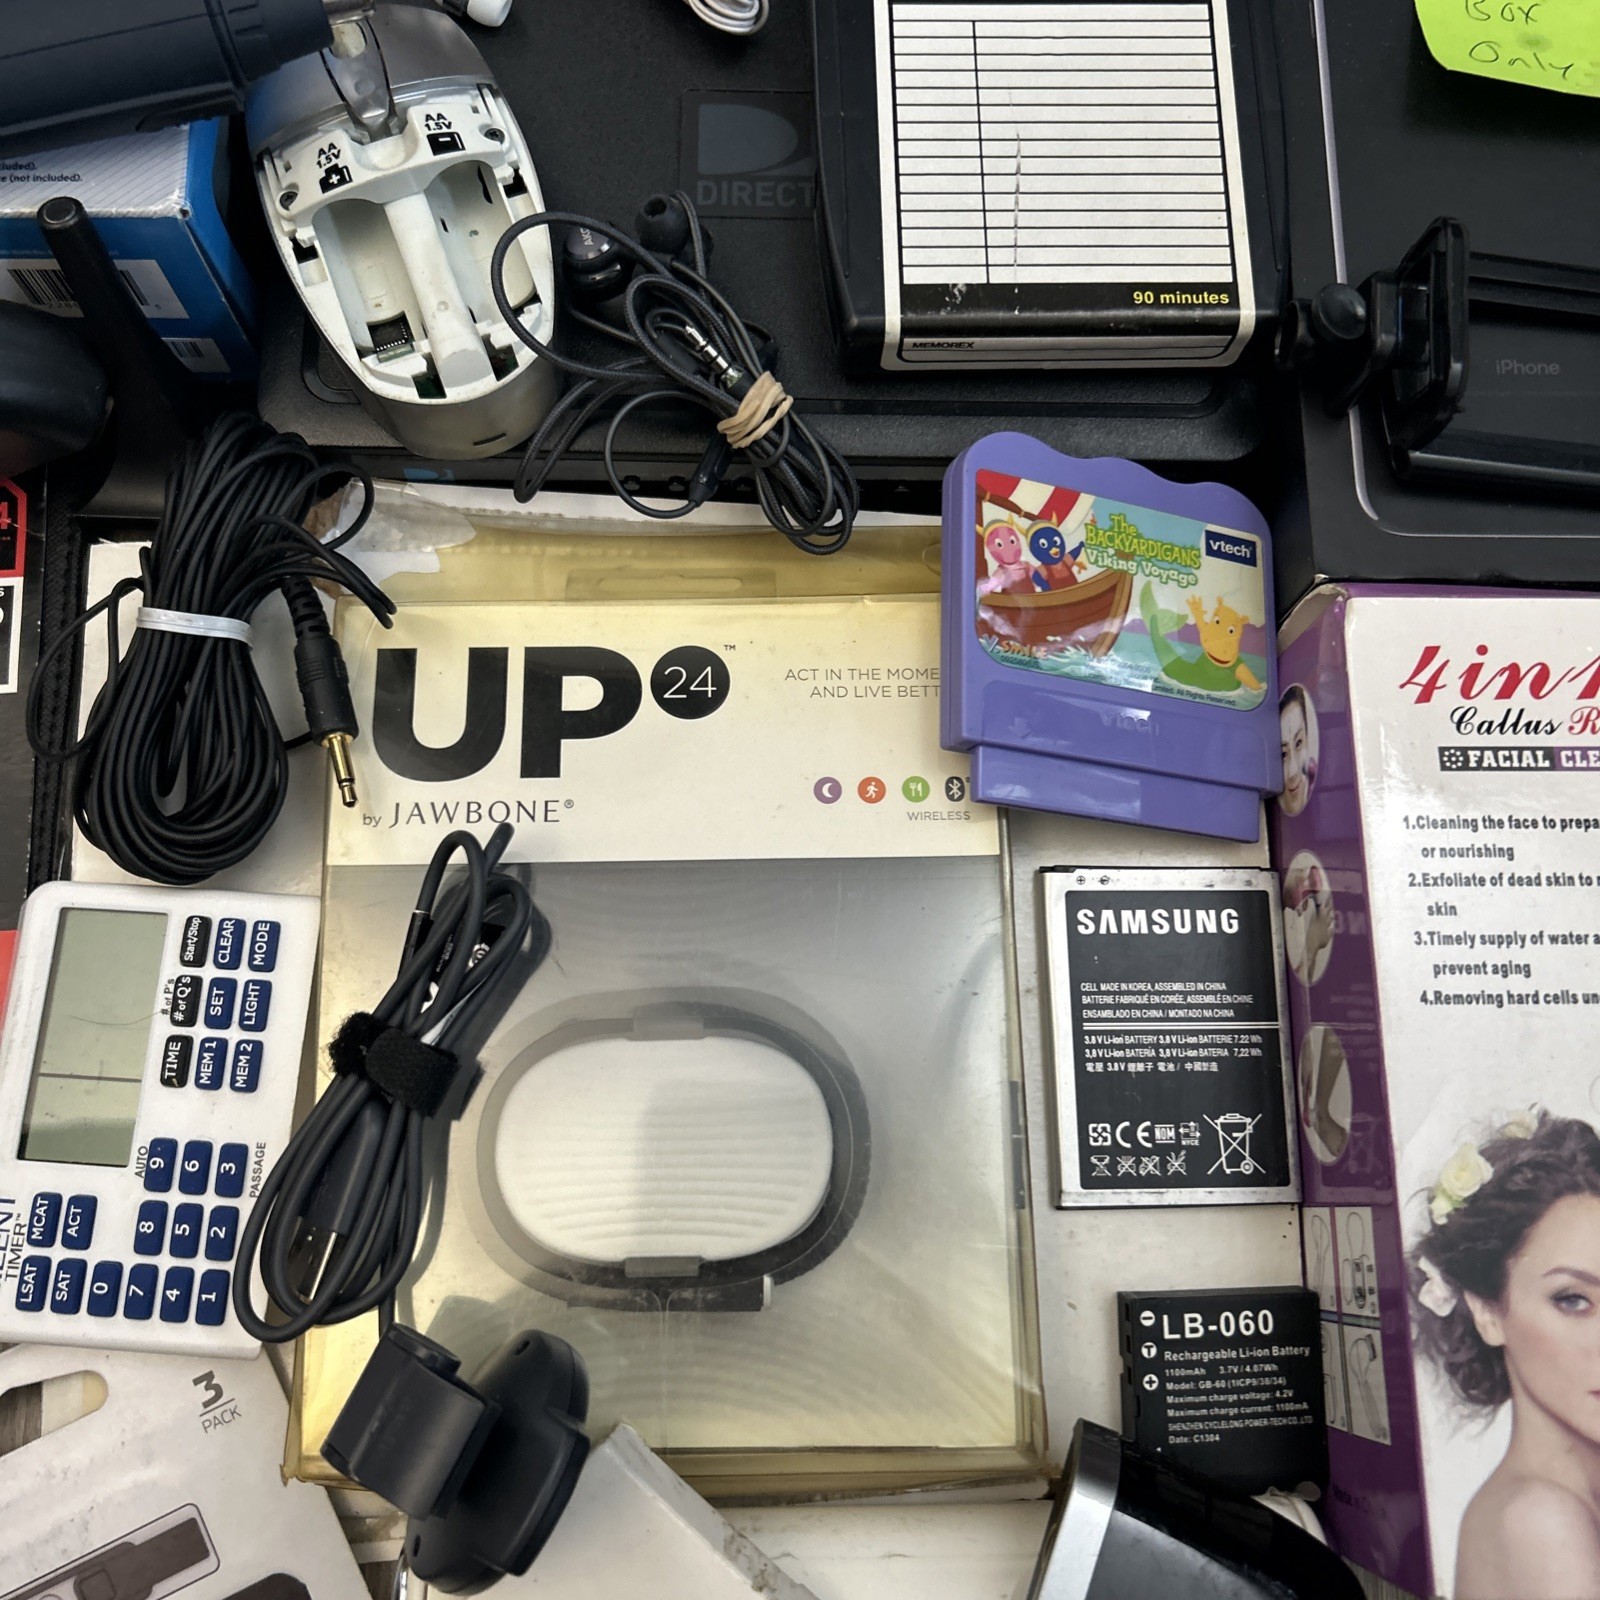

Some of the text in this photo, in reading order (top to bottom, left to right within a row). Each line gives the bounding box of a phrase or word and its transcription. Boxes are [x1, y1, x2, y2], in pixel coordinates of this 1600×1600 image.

[1468, 40, 1574, 80] Only
[424, 113, 448, 122] AA
[425, 121, 452, 132] 1.5V
[317, 142, 338, 159] AA
[316, 149, 341, 169] 1.5V
[1133, 291, 1229, 304] 90 minutes
[912, 341, 975, 349] MEMOREX
[1495, 359, 1560, 376] iPhone
[1109, 513, 1138, 536] The
[1084, 522, 1202, 569] BACKYARDIGANS
[1209, 539, 1252, 559] vtech
[1084, 548, 1199, 588] Viking Voyage
[784, 668, 819, 681] ACT
[825, 668, 842, 681] IN
[847, 668, 881, 681] THE
[810, 686, 848, 698] AND
[854, 685, 892, 698] LIVE
[372, 645, 717, 782] UP 24
[1450, 706, 1563, 735] Callus
[1467, 750, 1550, 768] FACIAL
[362, 814, 382, 829] by
[907, 811, 971, 821] WIRELESS
[1482, 815, 1505, 829] the
[1508, 815, 1539, 829] face
[1542, 816, 1557, 829] to
[1421, 844, 1515, 861] or nourishing
[1489, 872, 1504, 887] of
[1507, 872, 1542, 887] dead
[1545, 872, 1576, 887] skin
[1578, 873, 1593, 887] to
[1427, 901, 1458, 917] skin
[1076, 908, 1240, 935] SAMSUNG
[184, 917, 202, 962] Start/Stop
[218, 919, 236, 963] CLEAR
[253, 922, 270, 965] MODE
[1479, 931, 1527, 949] supply
[1530, 930, 1544, 945] of
[1547, 932, 1590, 945] water
[1433, 960, 1532, 979] prevent aging
[177, 976, 191, 998] Q's
[1080, 983, 1098, 991] CELL
[1100, 982, 1120, 991] MADE
[1128, 982, 1154, 992] KOREA,
[1154, 982, 1196, 991] ASSEMBLED
[1205, 982, 1227, 991] CHINA
[210, 987, 225, 1016] SET
[243, 983, 260, 1025] LIGHT
[1082, 995, 1115, 1004] BATTERIE
[1150, 995, 1160, 1003] EN
[1222, 994, 1232, 1003] EN
[1507, 990, 1540, 1005] hard
[1543, 990, 1579, 1005] cells
[1582, 992, 1600, 1005] un
[1082, 1008, 1235, 1018] ENSAMBLADO EN CHINA MONTADO NA CHINA
[1124, 1035, 1157, 1044] BATTERY
[1178, 1035, 1198, 1043] Li-ion
[1198, 1034, 1233, 1043] BATTERIE
[165, 1041, 181, 1079] TIME
[1104, 1048, 1125, 1057] Li-ion
[1178, 1048, 1198, 1057] Li-ion
[1199, 1048, 1229, 1057] BATERIA
[200, 1040, 217, 1084] MEM 1
[235, 1042, 253, 1088] MEM 2
[1155, 1127, 1175, 1139] NOM
[134, 1145, 149, 1178] AUTO
[150, 1157, 165, 1169] 9
[185, 1160, 199, 1172] 6
[221, 1162, 236, 1175] 3
[250, 1141, 267, 1198] PASSAGE
[31, 1196, 49, 1240] MCAT
[67, 1205, 82, 1237] ACT
[139, 1221, 154, 1233] 8
[175, 1223, 190, 1235] 5
[210, 1226, 226, 1239] 2
[20, 1263, 38, 1303] LSAT
[56, 1270, 71, 1302] SAT
[93, 1282, 109, 1295] 0
[129, 1285, 144, 1297] 7
[166, 1288, 181, 1302] 4
[201, 1292, 216, 1302] 1
[1162, 1309, 1274, 1339] LB-060
[1164, 1346, 1310, 1362] Rechargeable Li-ion Battery
[1165, 1367, 1206, 1377] 1100mAh
[1219, 1365, 1238, 1374] 3.7V
[192, 1370, 224, 1409] 3
[1165, 1379, 1226, 1391] Model: GB-60
[1166, 1389, 1294, 1404] Maximum charge voltage: 4.2V
[1167, 1402, 1309, 1417] Maximum charge current: 1100mA
[202, 1404, 242, 1434] PACK
[1168, 1435, 1191, 1444] Date:
